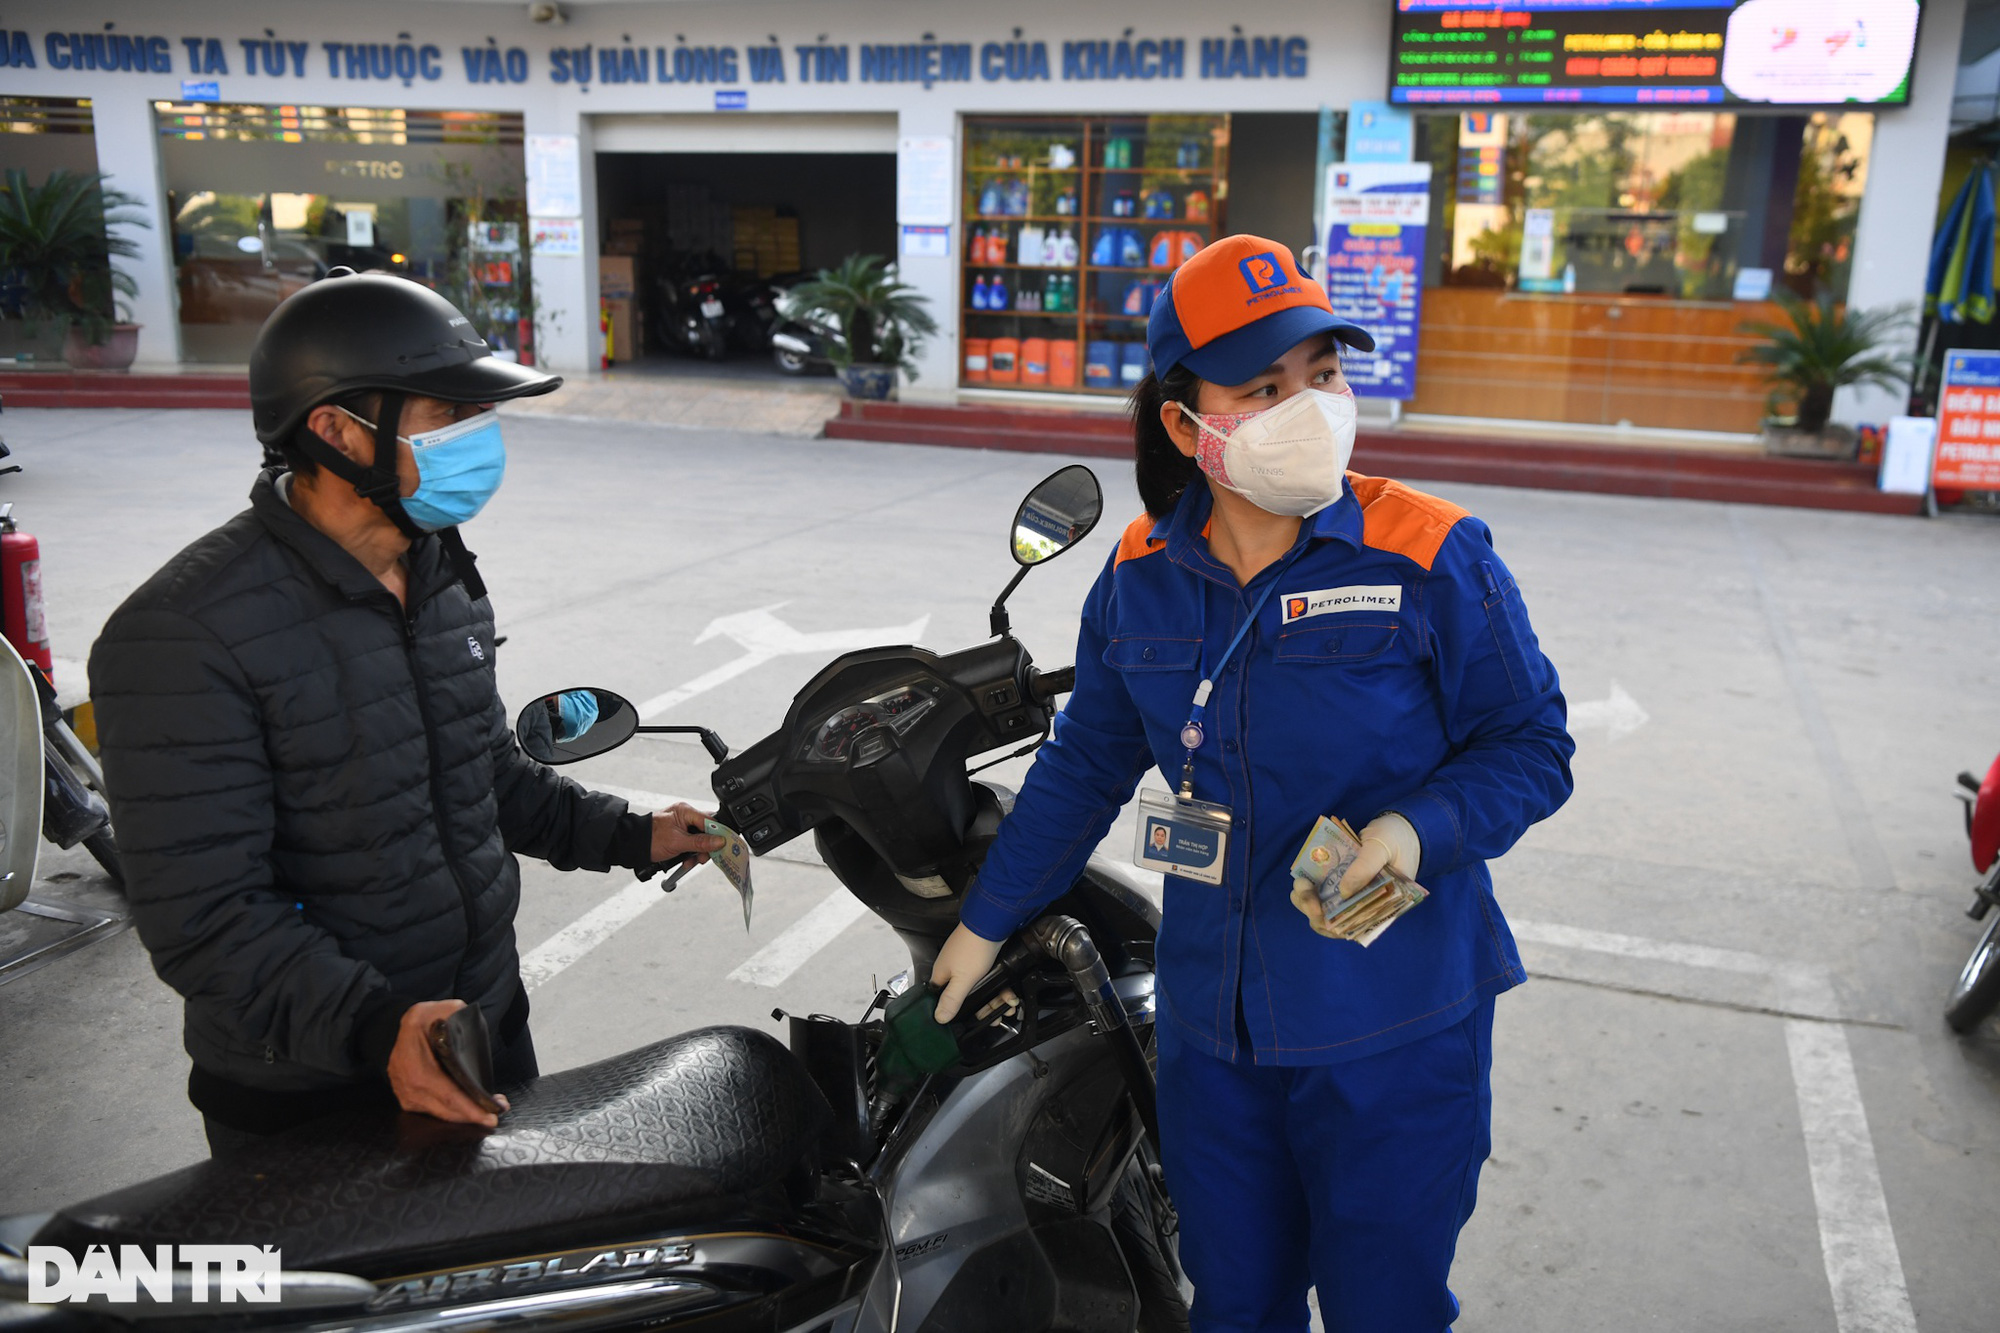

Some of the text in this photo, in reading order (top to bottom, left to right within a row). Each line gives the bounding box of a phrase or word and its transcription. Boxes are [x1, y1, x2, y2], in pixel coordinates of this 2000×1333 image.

[45, 22, 172, 74] CHÚNG
[181, 37, 229, 75] TA
[239, 28, 309, 78] TÙY
[322, 32, 443, 88] THUỘC
[461, 36, 529, 84] VÀO
[549, 43, 593, 94] SỰ
[598, 33, 650, 84] HÀI
[656, 33, 739, 84] LÒNG
[746, 33, 786, 84] VÀ
[795, 34, 849, 84] TÍN
[860, 31, 972, 91] NHIỆM
[981, 26, 1050, 82] CỦA
[1062, 27, 1186, 81] KHÁCH
[1200, 25, 1309, 80] HÀNG
[1310, 595, 1396, 610] PETROLIMEX
[372, 1243, 695, 1308] AIR BLADE
